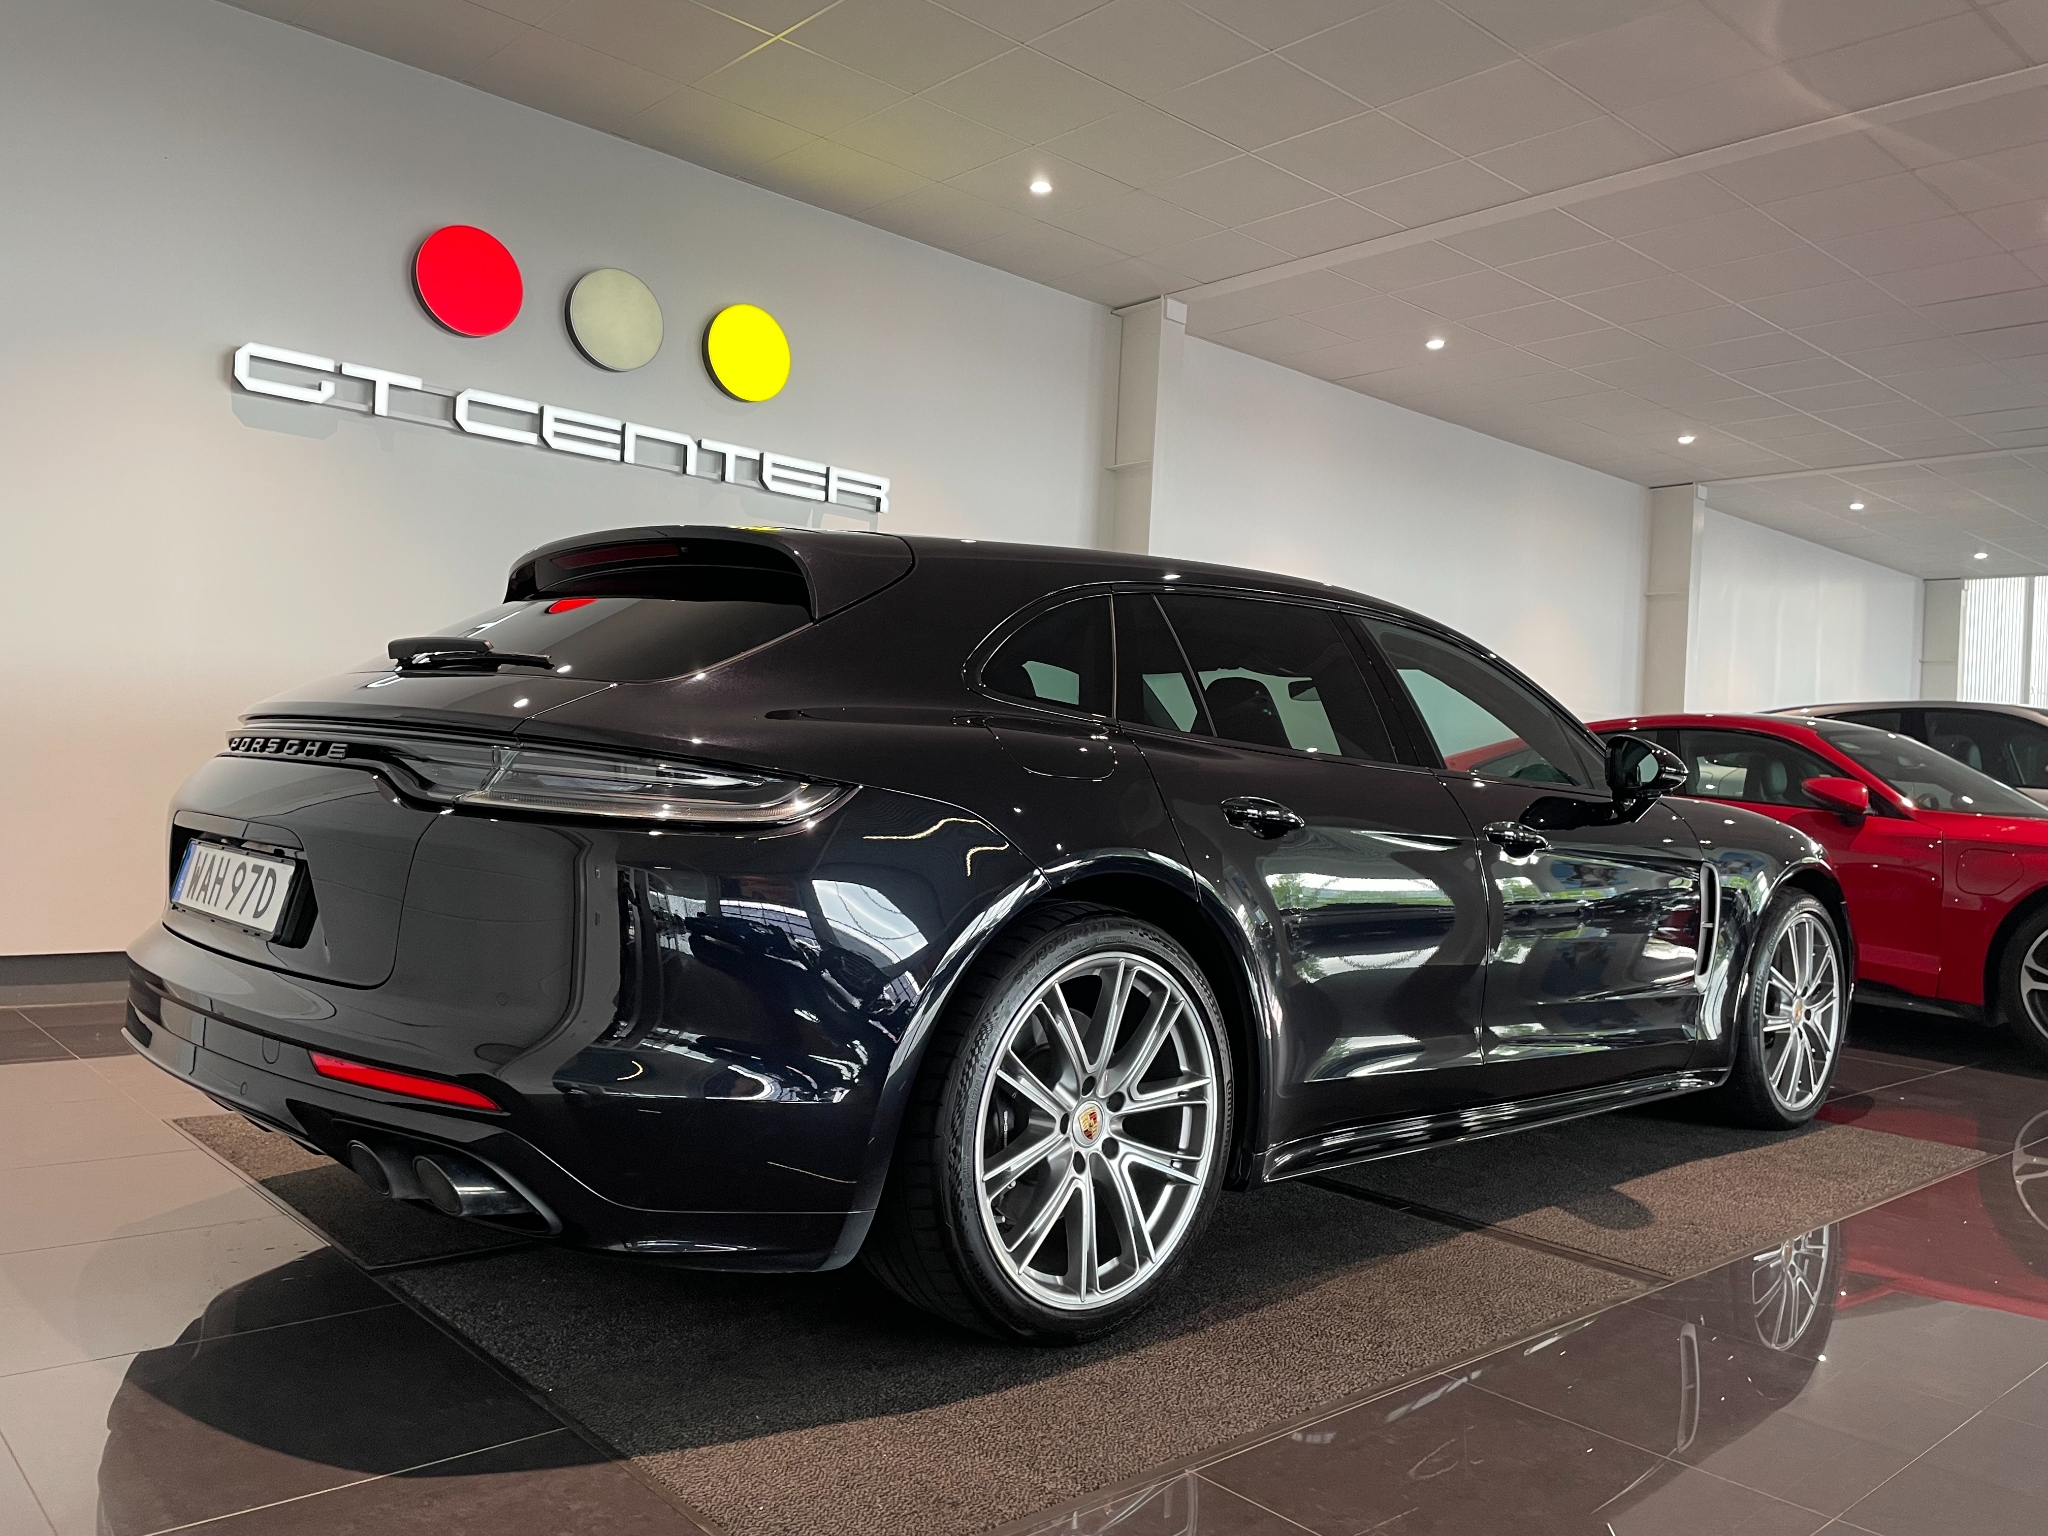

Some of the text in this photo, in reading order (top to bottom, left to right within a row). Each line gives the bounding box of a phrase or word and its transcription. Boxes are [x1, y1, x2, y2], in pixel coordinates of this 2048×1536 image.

[234, 341, 891, 513] GT CENTER
[230, 737, 349, 759] PORSCHE
[186, 851, 277, 919] WAH 97D
